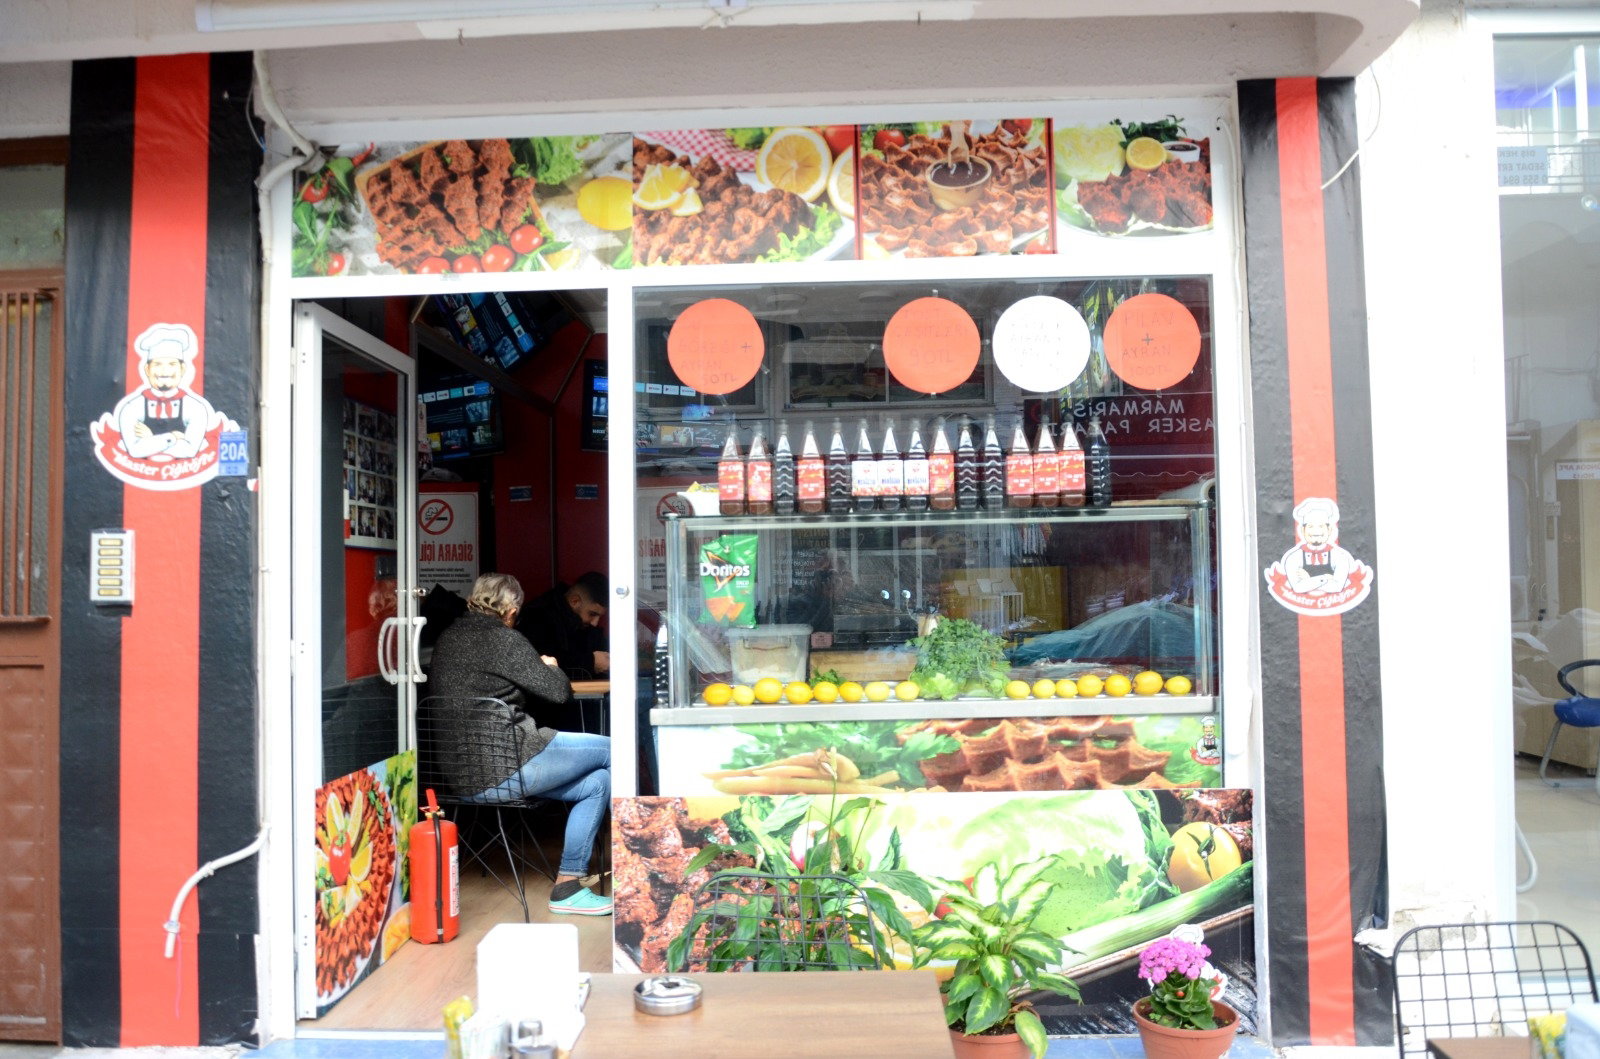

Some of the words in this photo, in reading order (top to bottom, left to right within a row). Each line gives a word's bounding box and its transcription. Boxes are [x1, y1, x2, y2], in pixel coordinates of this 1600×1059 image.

[220, 442, 247, 461] 20A
[111, 447, 159, 476] Master
[699, 562, 751, 577] Doritos
